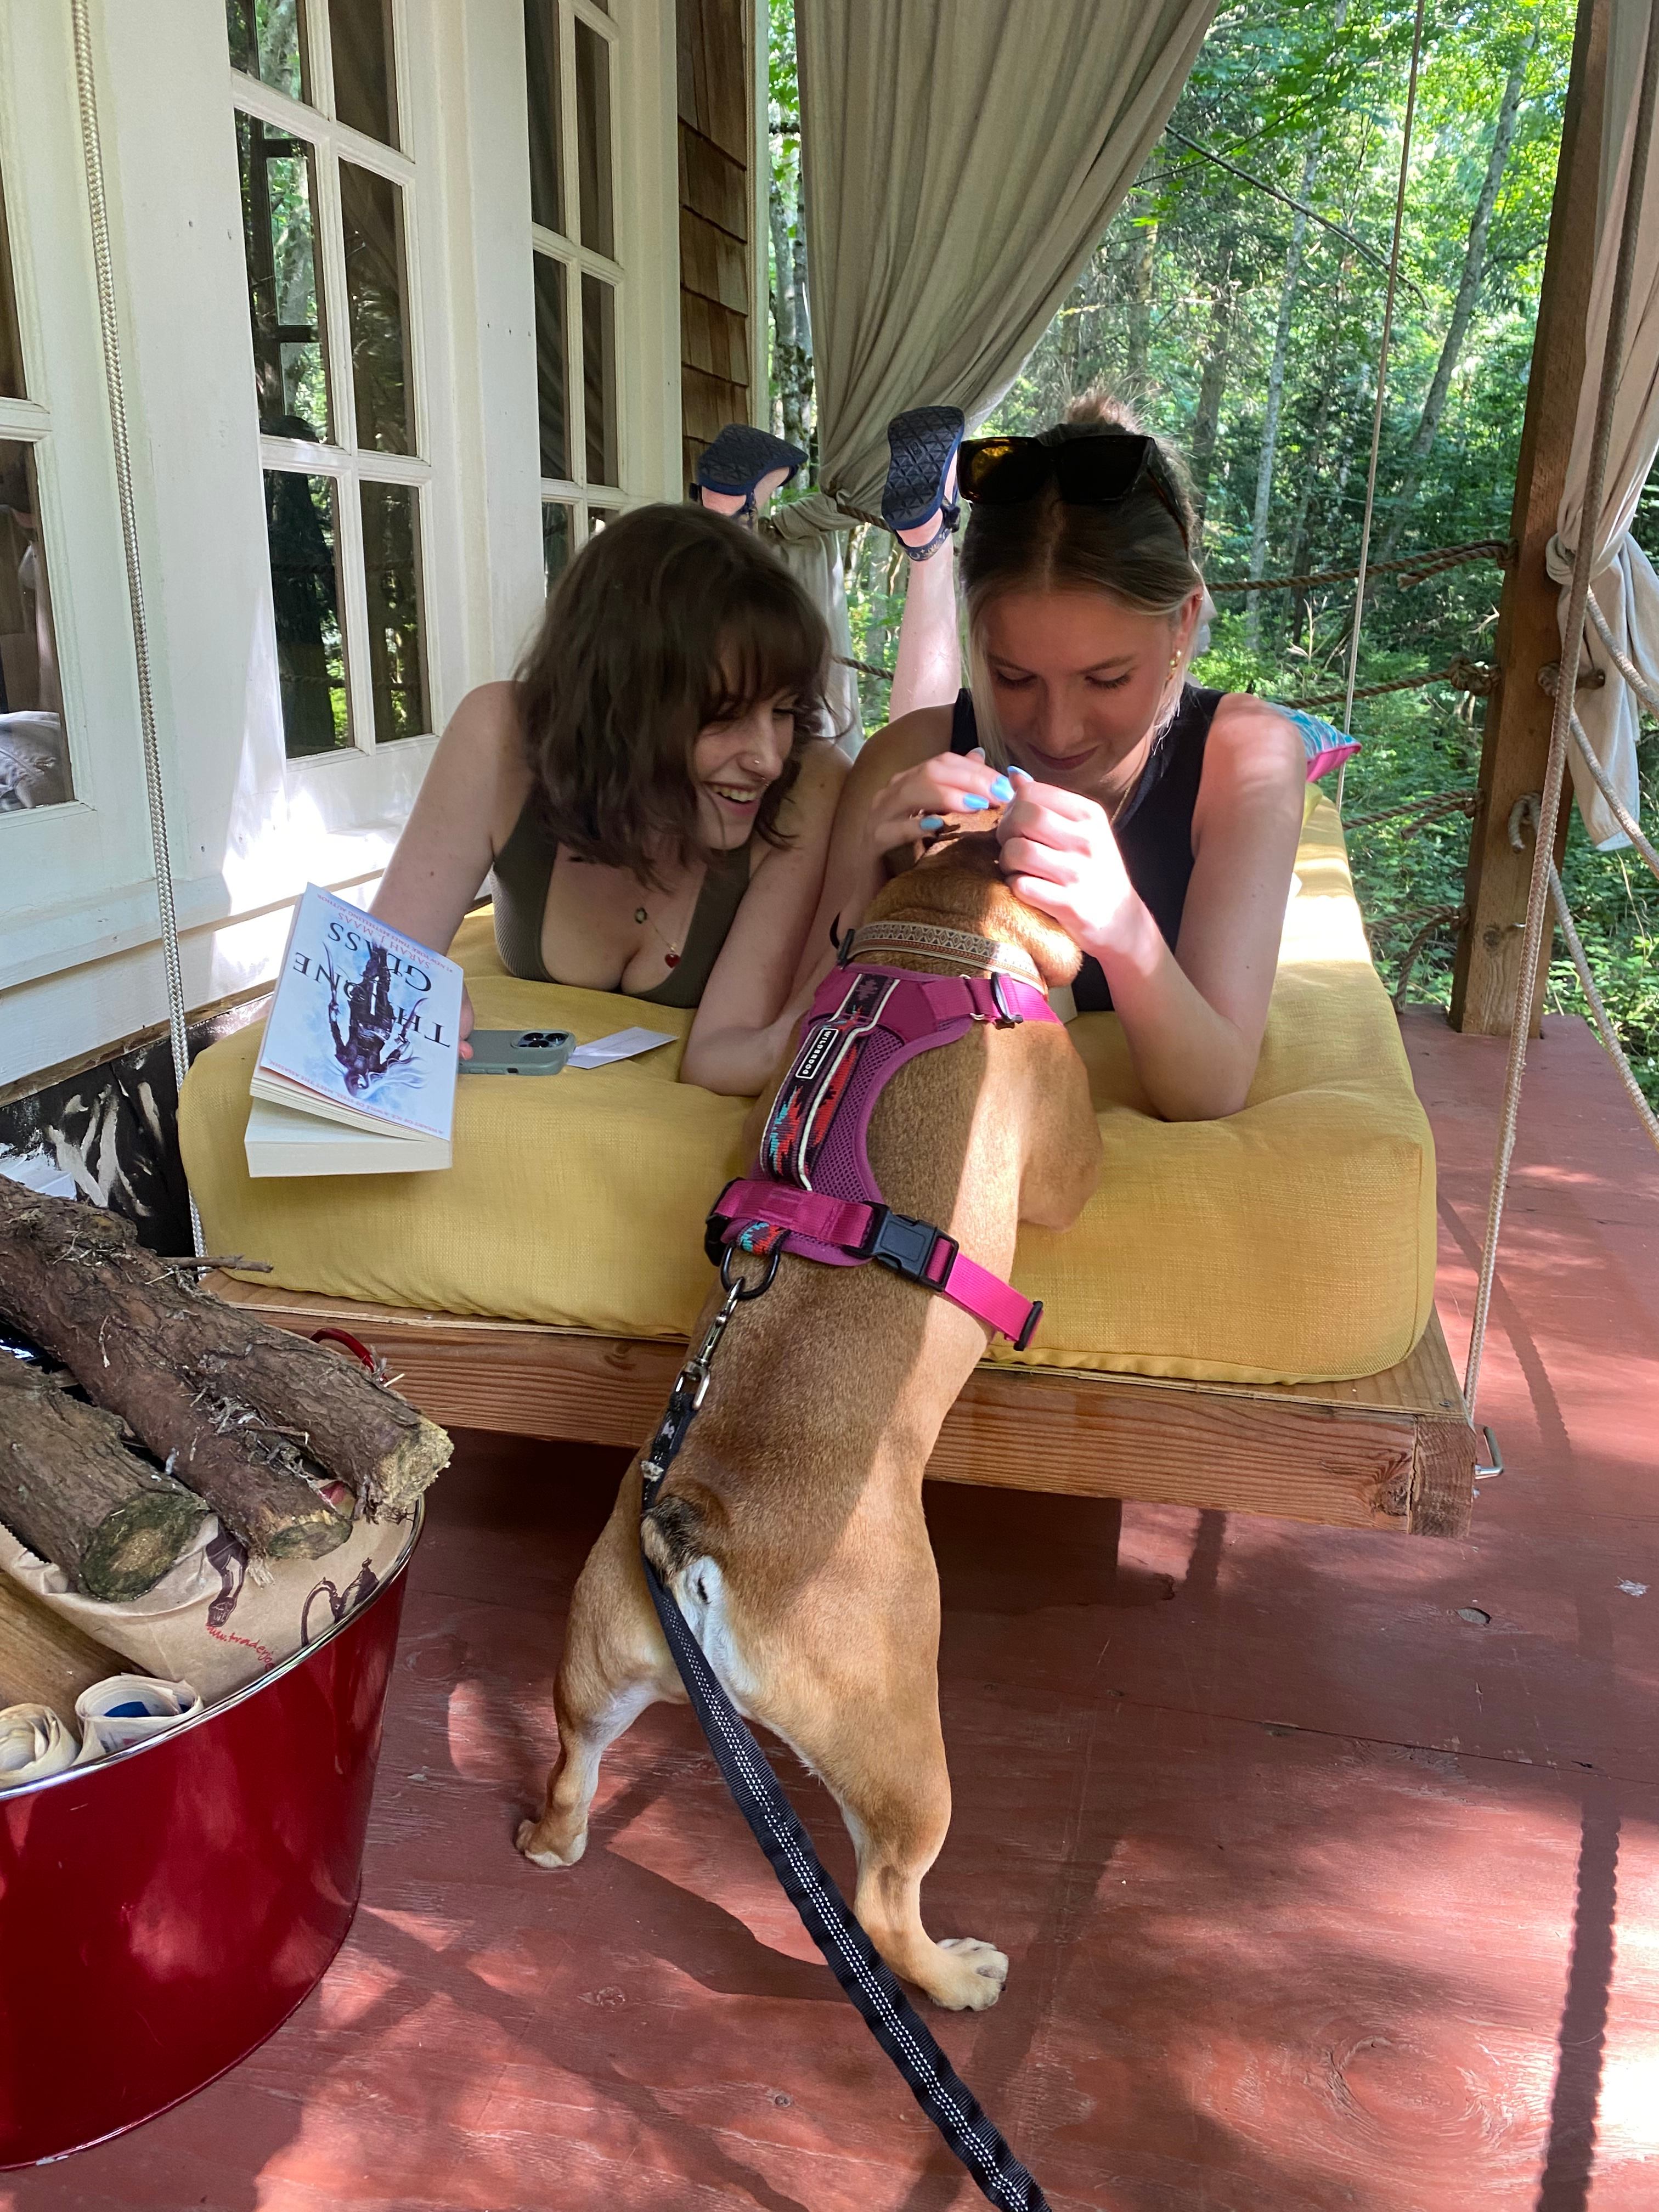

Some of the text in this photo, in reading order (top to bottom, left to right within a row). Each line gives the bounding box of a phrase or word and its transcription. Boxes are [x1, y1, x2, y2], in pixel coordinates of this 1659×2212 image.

[317, 894, 346, 911] AUTHOR
[338, 913, 373, 936] MAAS
[348, 911, 390, 936] BESTSELLING
[378, 934, 385, 943] J.
[392, 936, 410, 949] TIMES
[390, 942, 430, 969] SARAH
[412, 947, 429, 960] YORK
[430, 959, 445, 969] NEW
[293, 952, 450, 1048] THONE
[802, 1031, 832, 1075] WILDERDOG
[301, 1076, 314, 1086] THE
